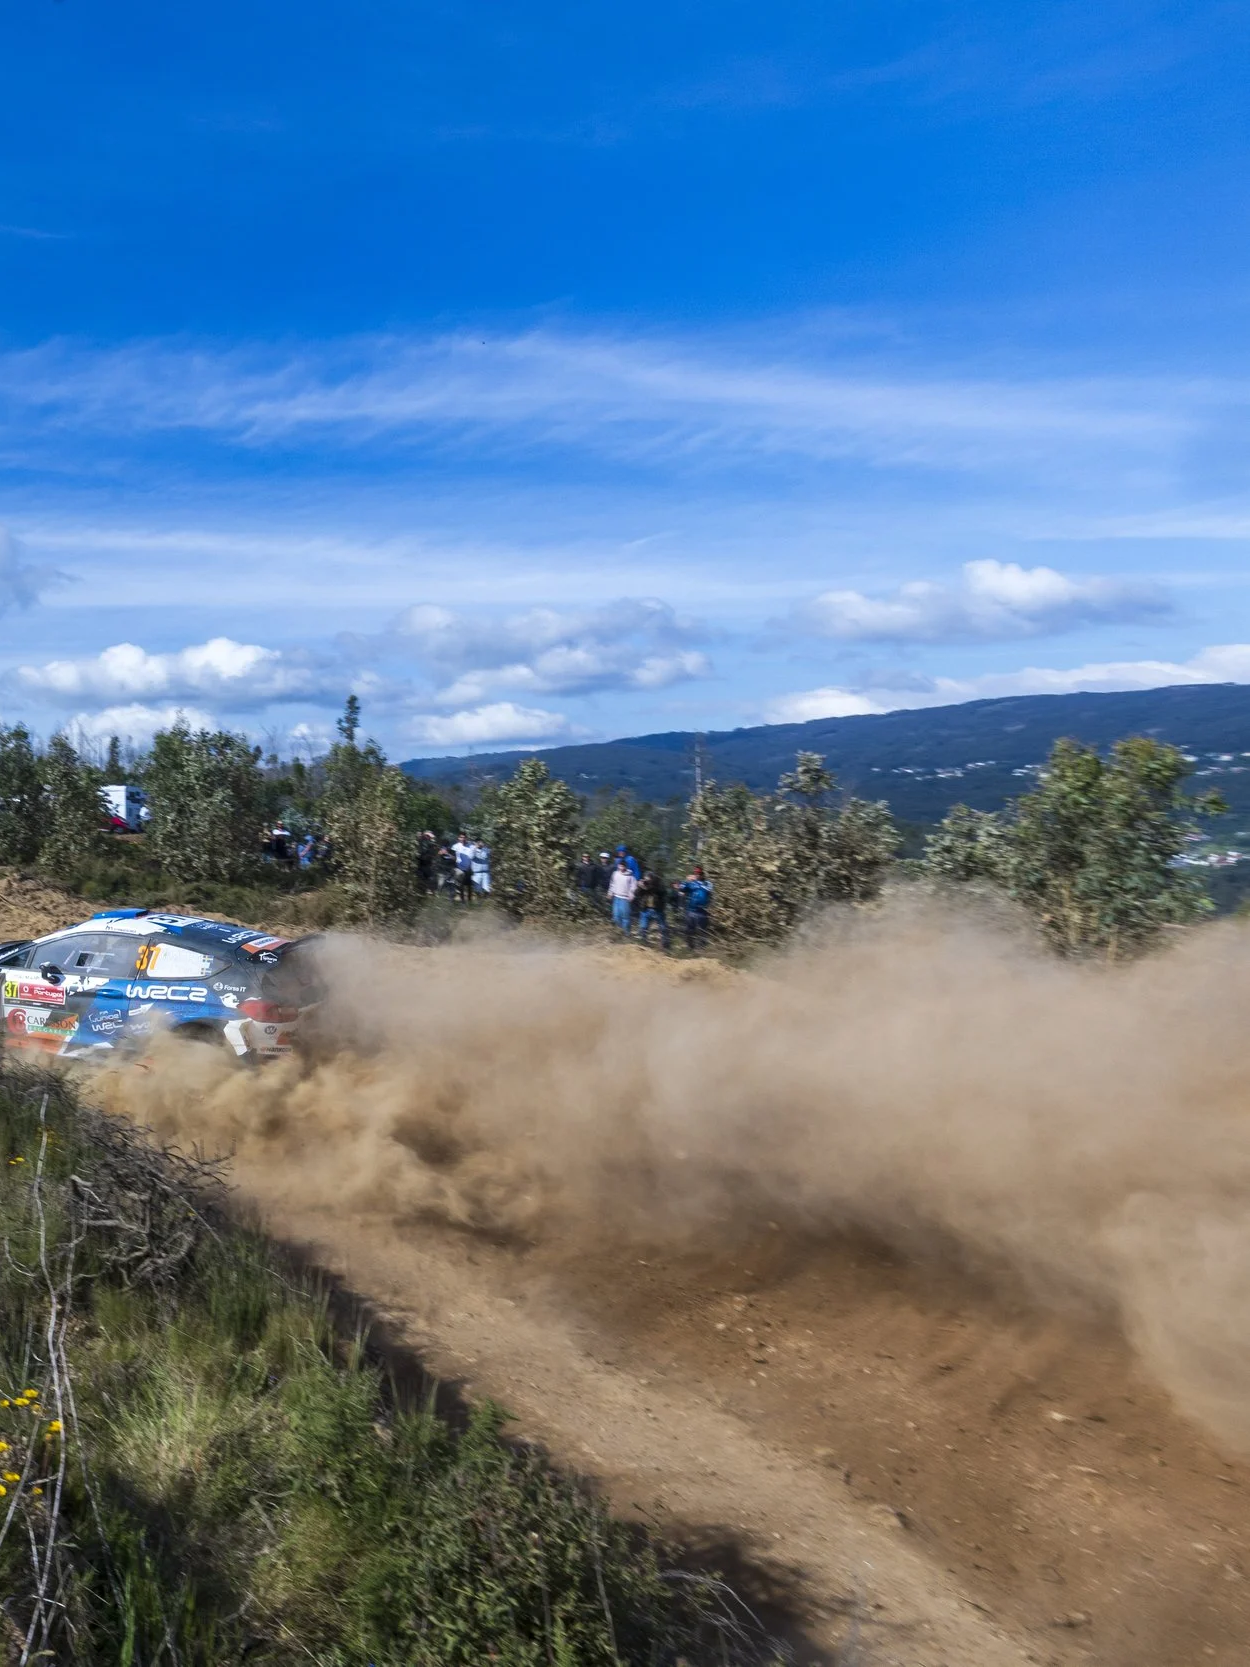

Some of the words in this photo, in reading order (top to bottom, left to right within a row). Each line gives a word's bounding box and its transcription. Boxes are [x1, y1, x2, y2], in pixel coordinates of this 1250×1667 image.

[134, 945, 161, 970] 37
[5, 981, 18, 998] 37
[33, 989, 65, 999] Portugal
[125, 984, 208, 1002] WRC2
[91, 1019, 124, 1032] WRC
